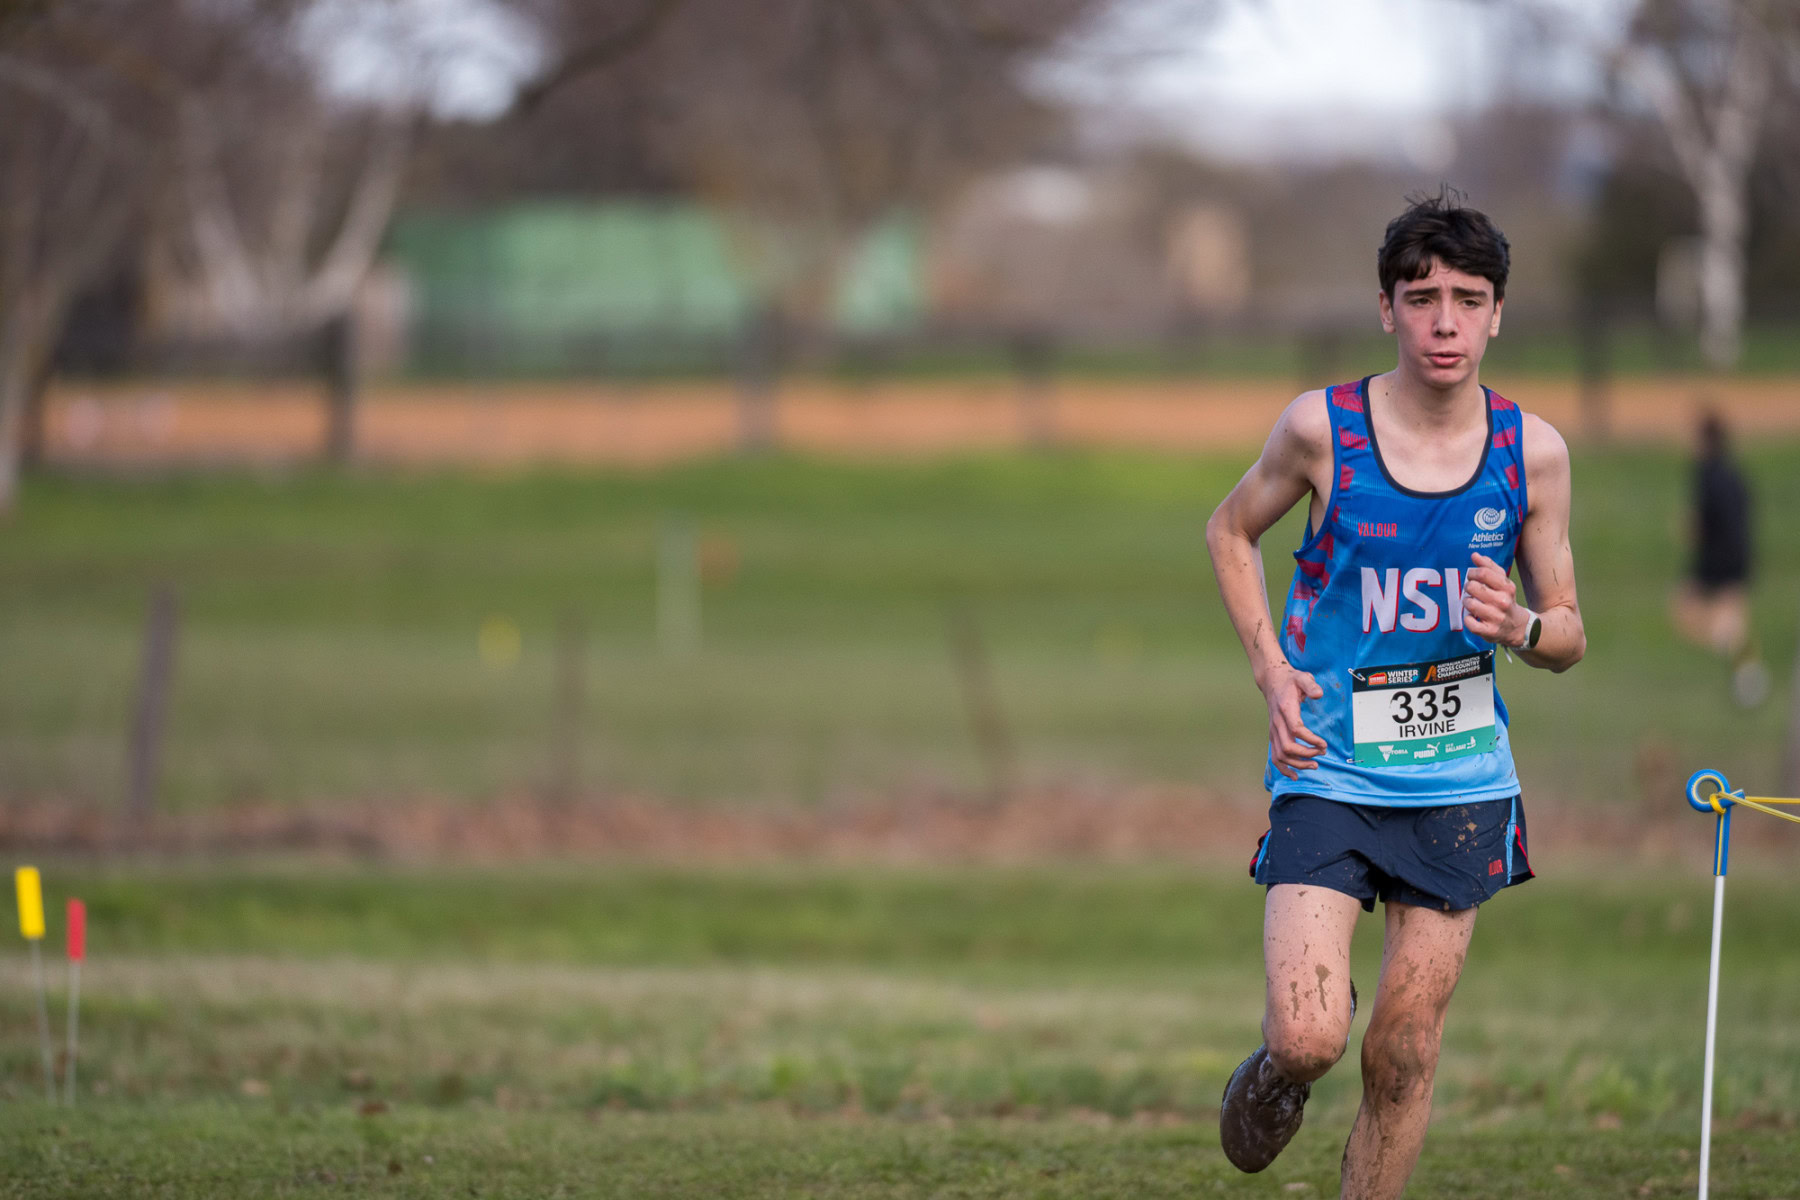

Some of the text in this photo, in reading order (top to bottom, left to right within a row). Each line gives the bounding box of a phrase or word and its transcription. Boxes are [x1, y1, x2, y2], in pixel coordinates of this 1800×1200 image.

[1358, 522, 1397, 537] VALOUR
[1471, 532, 1504, 543] Athletics
[1437, 660, 1480, 673] CROSS COUNTRY
[1437, 665, 1480, 678] CHAMPIONSHIPS
[1388, 669, 1419, 678] WINTER
[1388, 676, 1413, 684] SERIES
[1391, 684, 1461, 723] 335
[1399, 719, 1456, 738] IRVINE
[1414, 749, 1436, 759] PUMA
